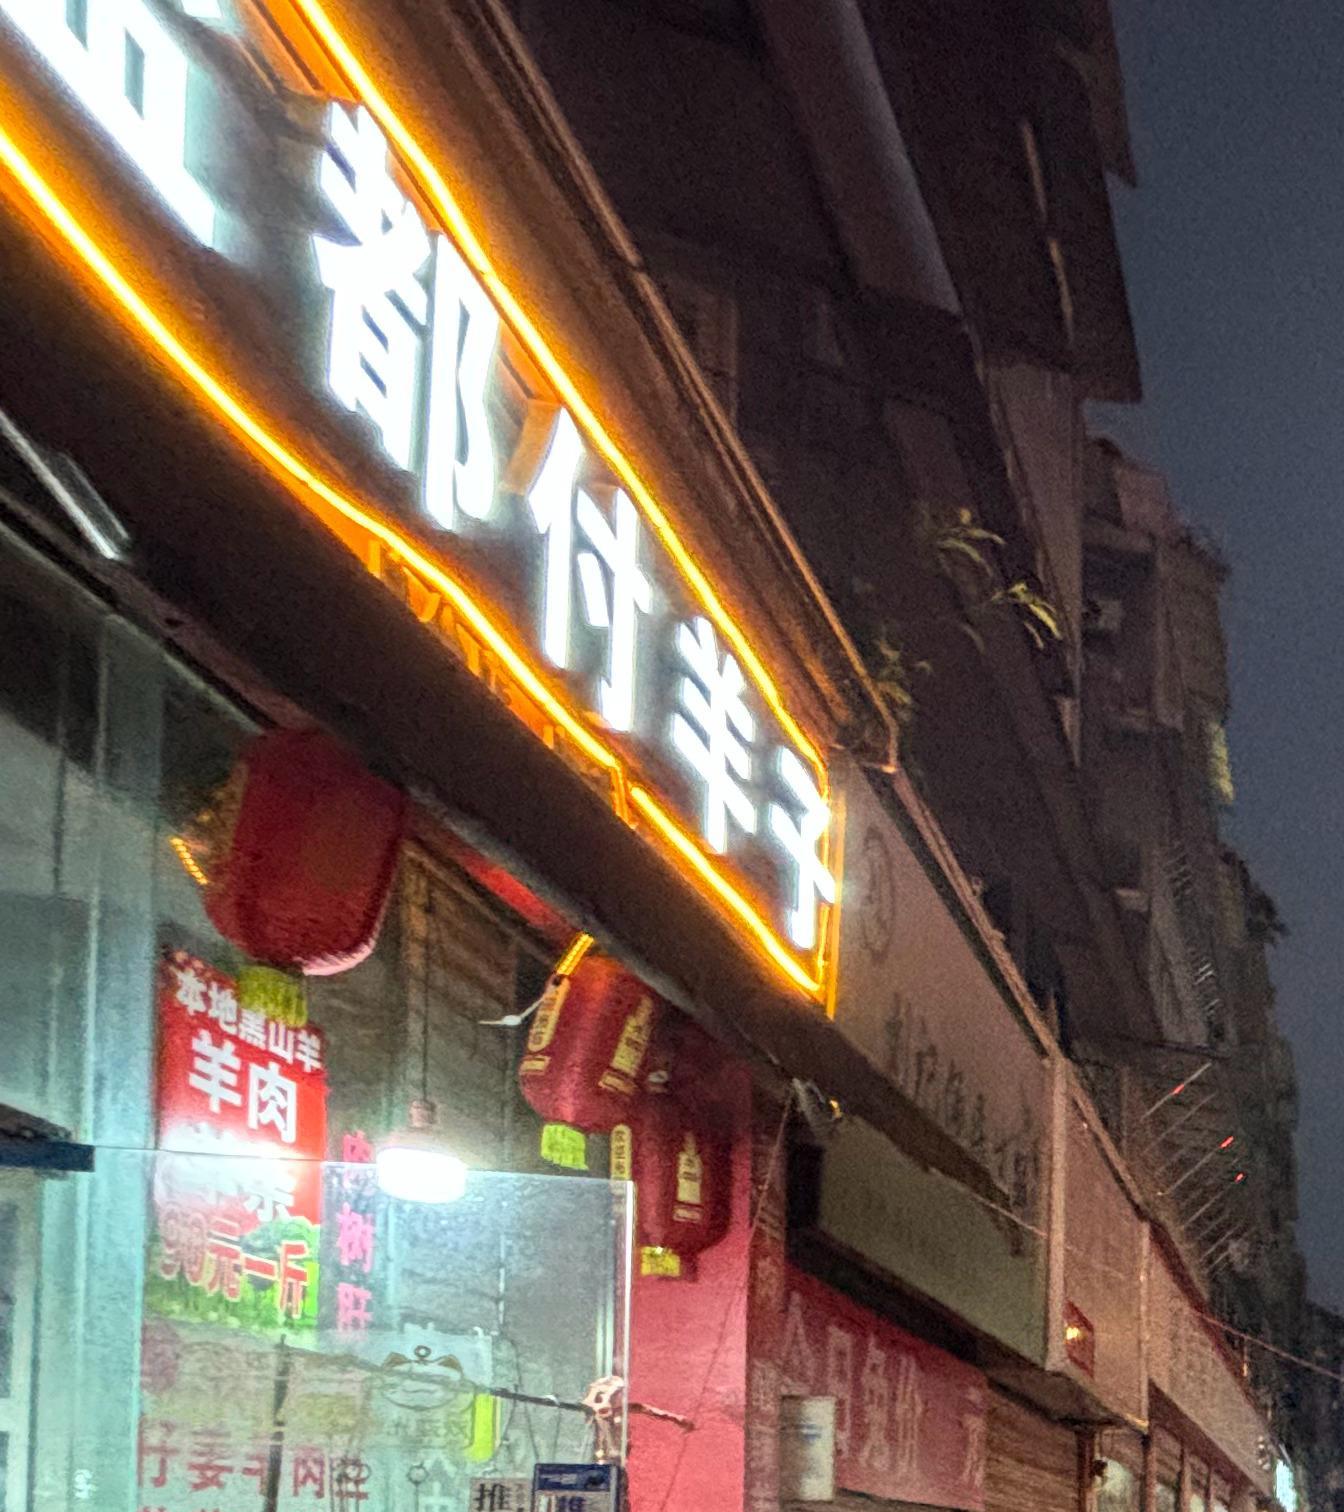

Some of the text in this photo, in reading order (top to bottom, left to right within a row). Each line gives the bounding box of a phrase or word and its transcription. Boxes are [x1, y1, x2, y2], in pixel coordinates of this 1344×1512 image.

[173, 967, 322, 1073] 本地黑山羊
[189, 1029, 298, 1144] 羊肉
[474, 1482, 512, 1512] 推
